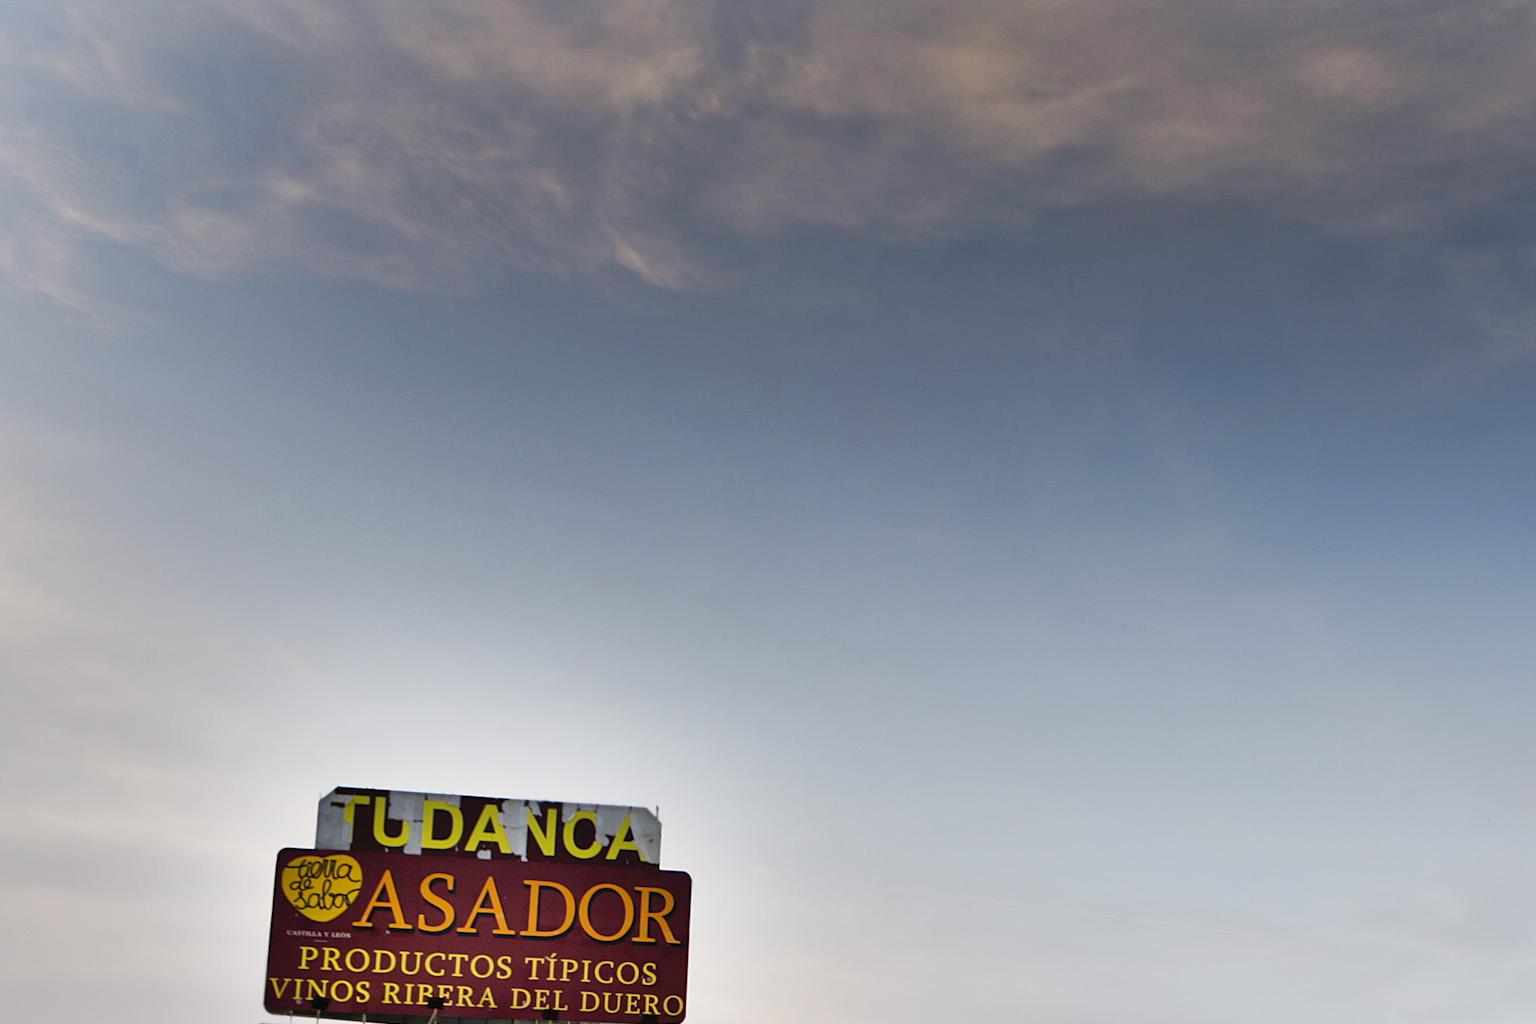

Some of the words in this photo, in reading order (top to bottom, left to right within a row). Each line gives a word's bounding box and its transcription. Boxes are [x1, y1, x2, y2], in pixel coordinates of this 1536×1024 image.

[338, 795, 647, 862] TUDANCA
[289, 879, 314, 891] de
[352, 869, 681, 944] ASADOR
[286, 929, 322, 938] CASTILLA
[298, 946, 512, 979] PRODUCTOS
[525, 953, 657, 986] TÍPICOS
[269, 977, 371, 1003] VINOS
[382, 982, 498, 1009] RIBERA
[510, 988, 568, 1011] DEL
[579, 991, 684, 1016] DUERO
